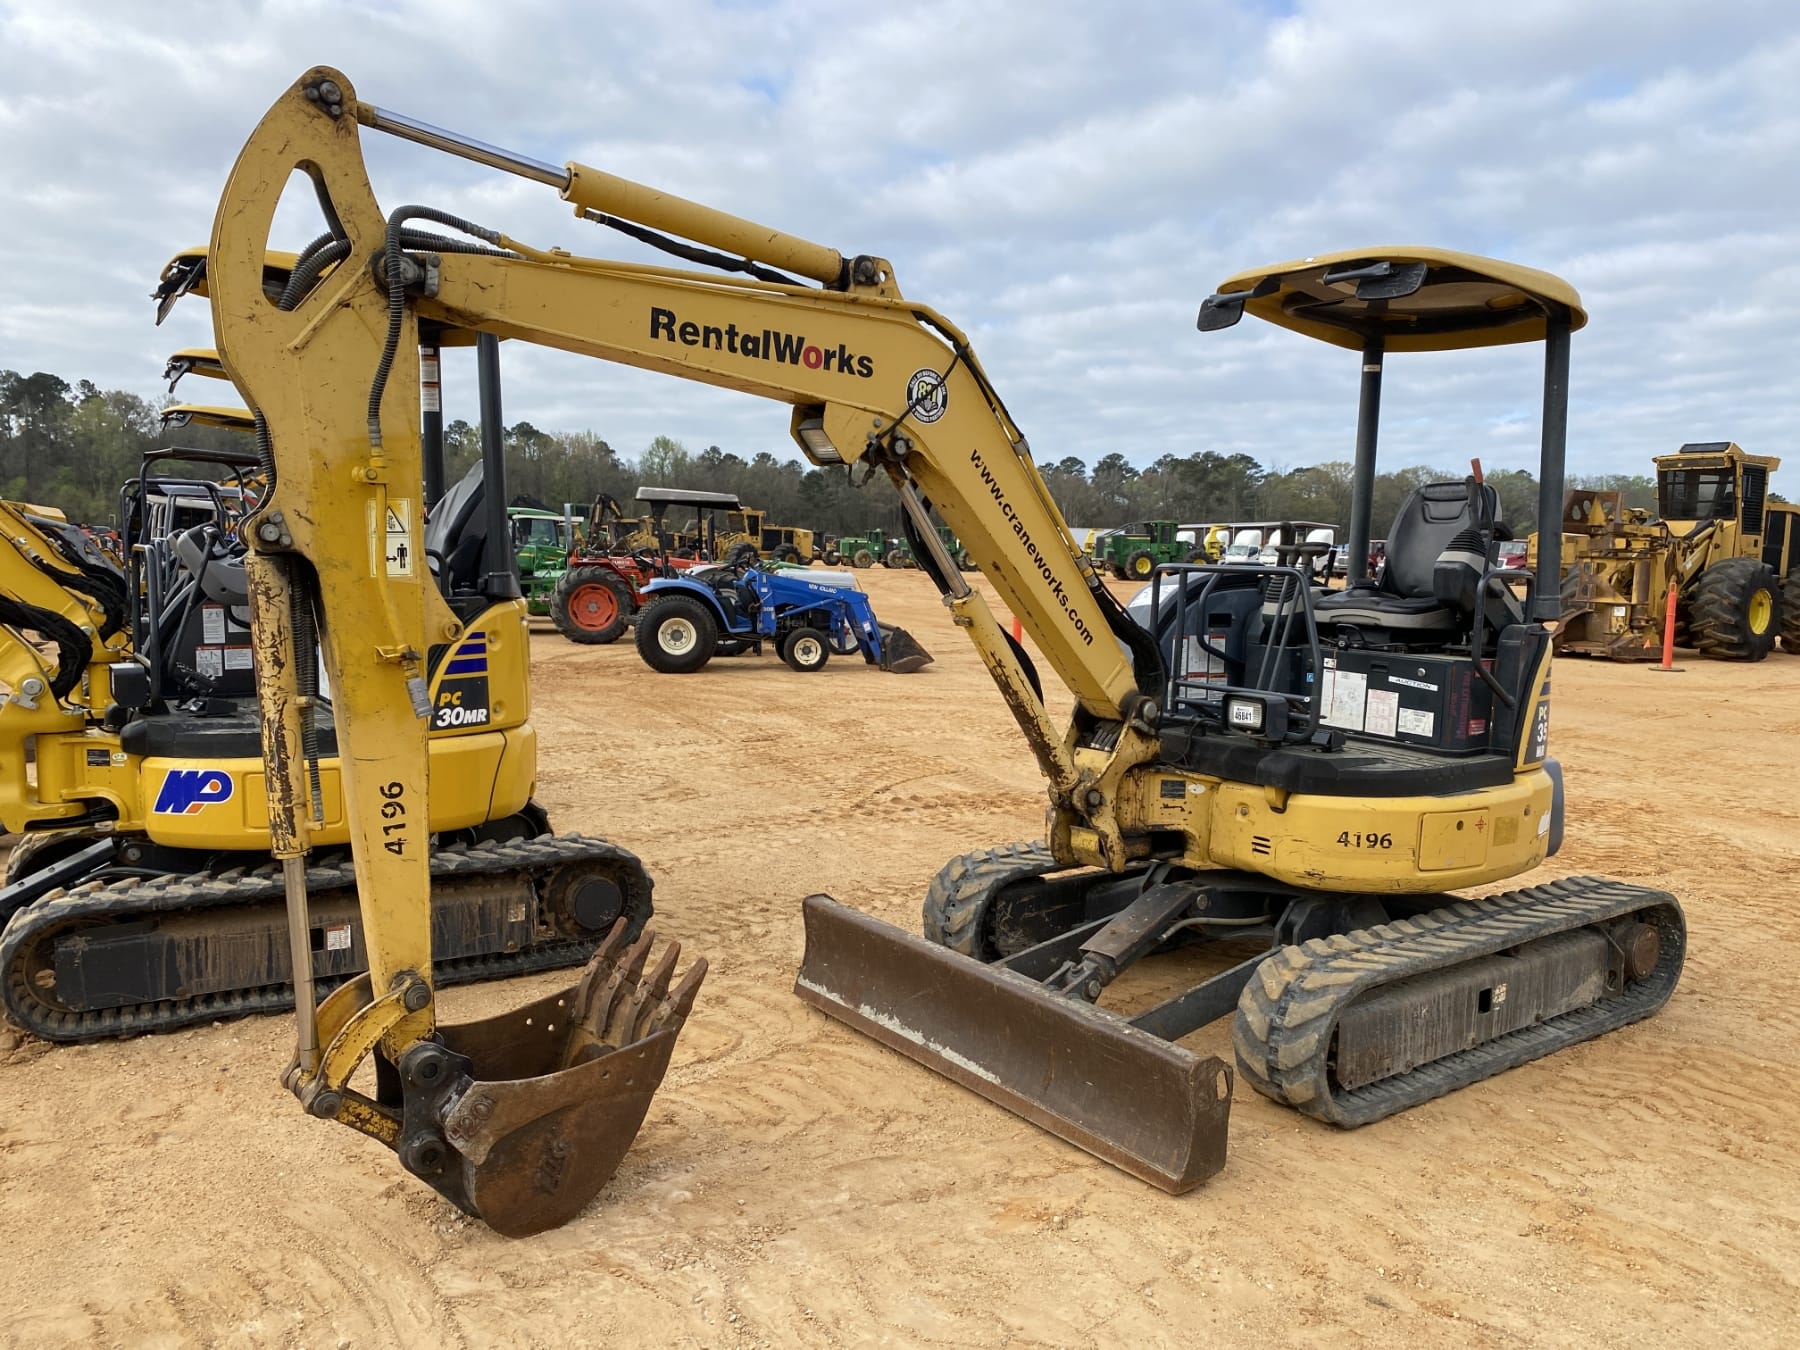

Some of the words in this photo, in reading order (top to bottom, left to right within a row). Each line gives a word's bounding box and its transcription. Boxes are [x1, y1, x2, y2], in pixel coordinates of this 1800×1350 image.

[650, 306, 873, 378] RentalWorks
[970, 449, 1094, 646] www.craneworks.com
[436, 706, 488, 727] 30MR
[439, 691, 462, 707] PC
[379, 782, 407, 855] 4196
[1336, 831, 1393, 849] 4196
